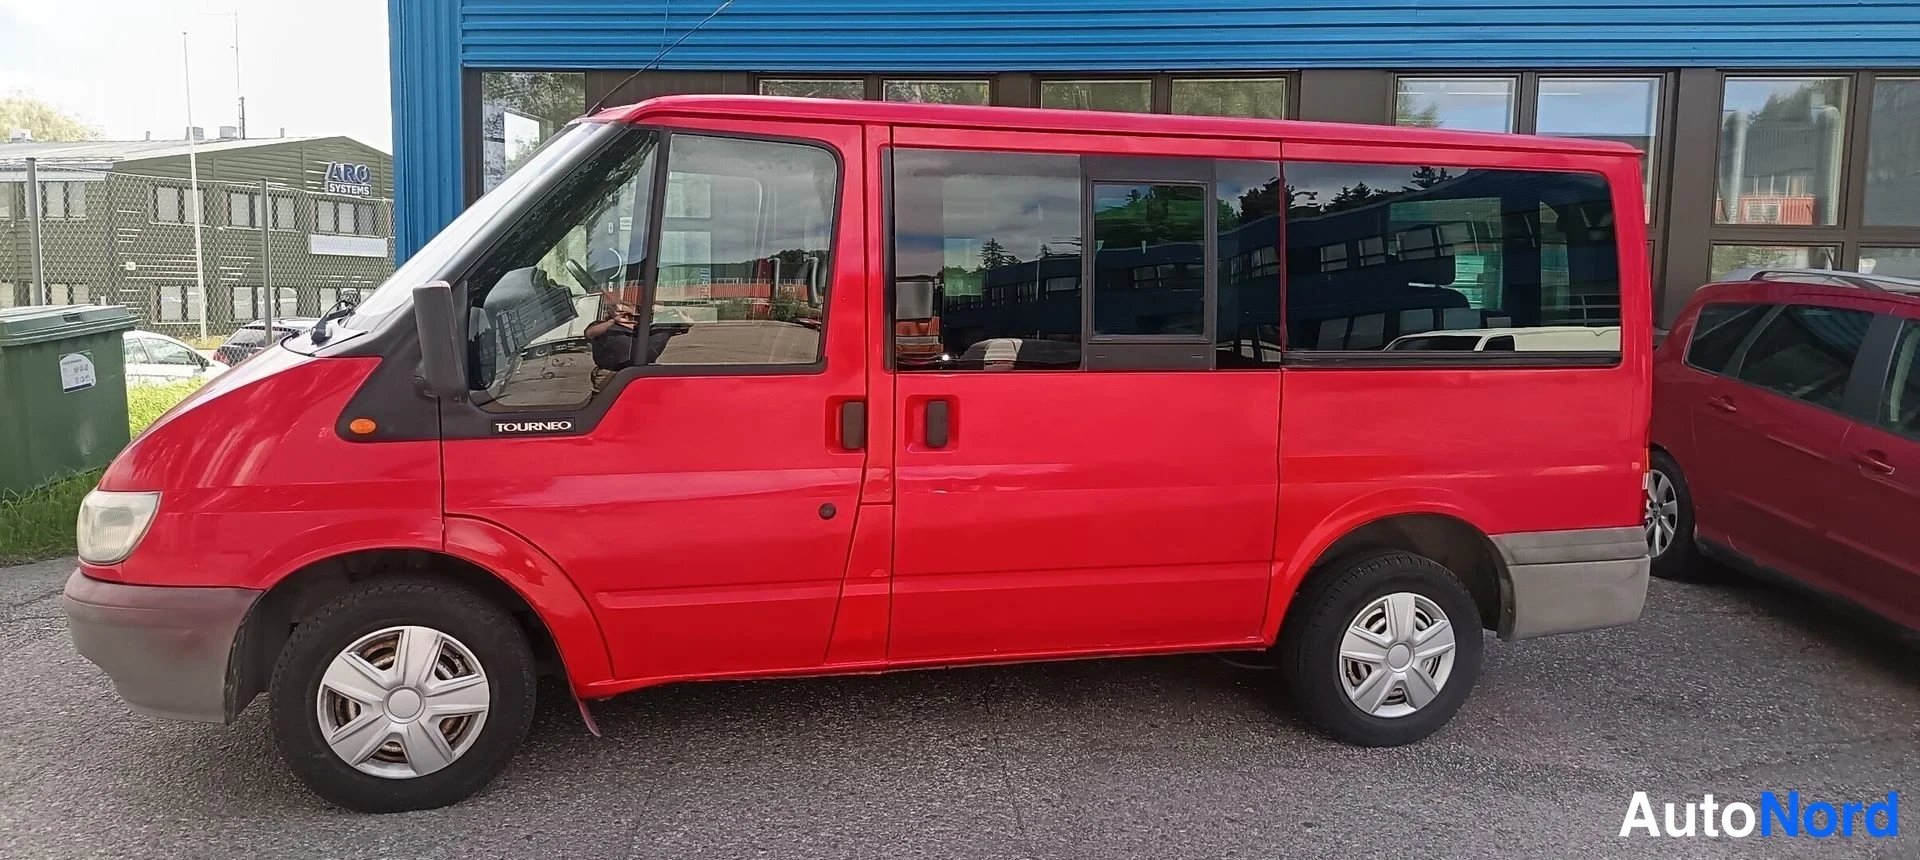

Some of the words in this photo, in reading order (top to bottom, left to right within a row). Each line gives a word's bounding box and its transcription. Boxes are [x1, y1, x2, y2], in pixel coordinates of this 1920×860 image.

[327, 162, 371, 183] ARO
[329, 183, 370, 196] SYSTEMS
[495, 420, 572, 433] TOURNEO
